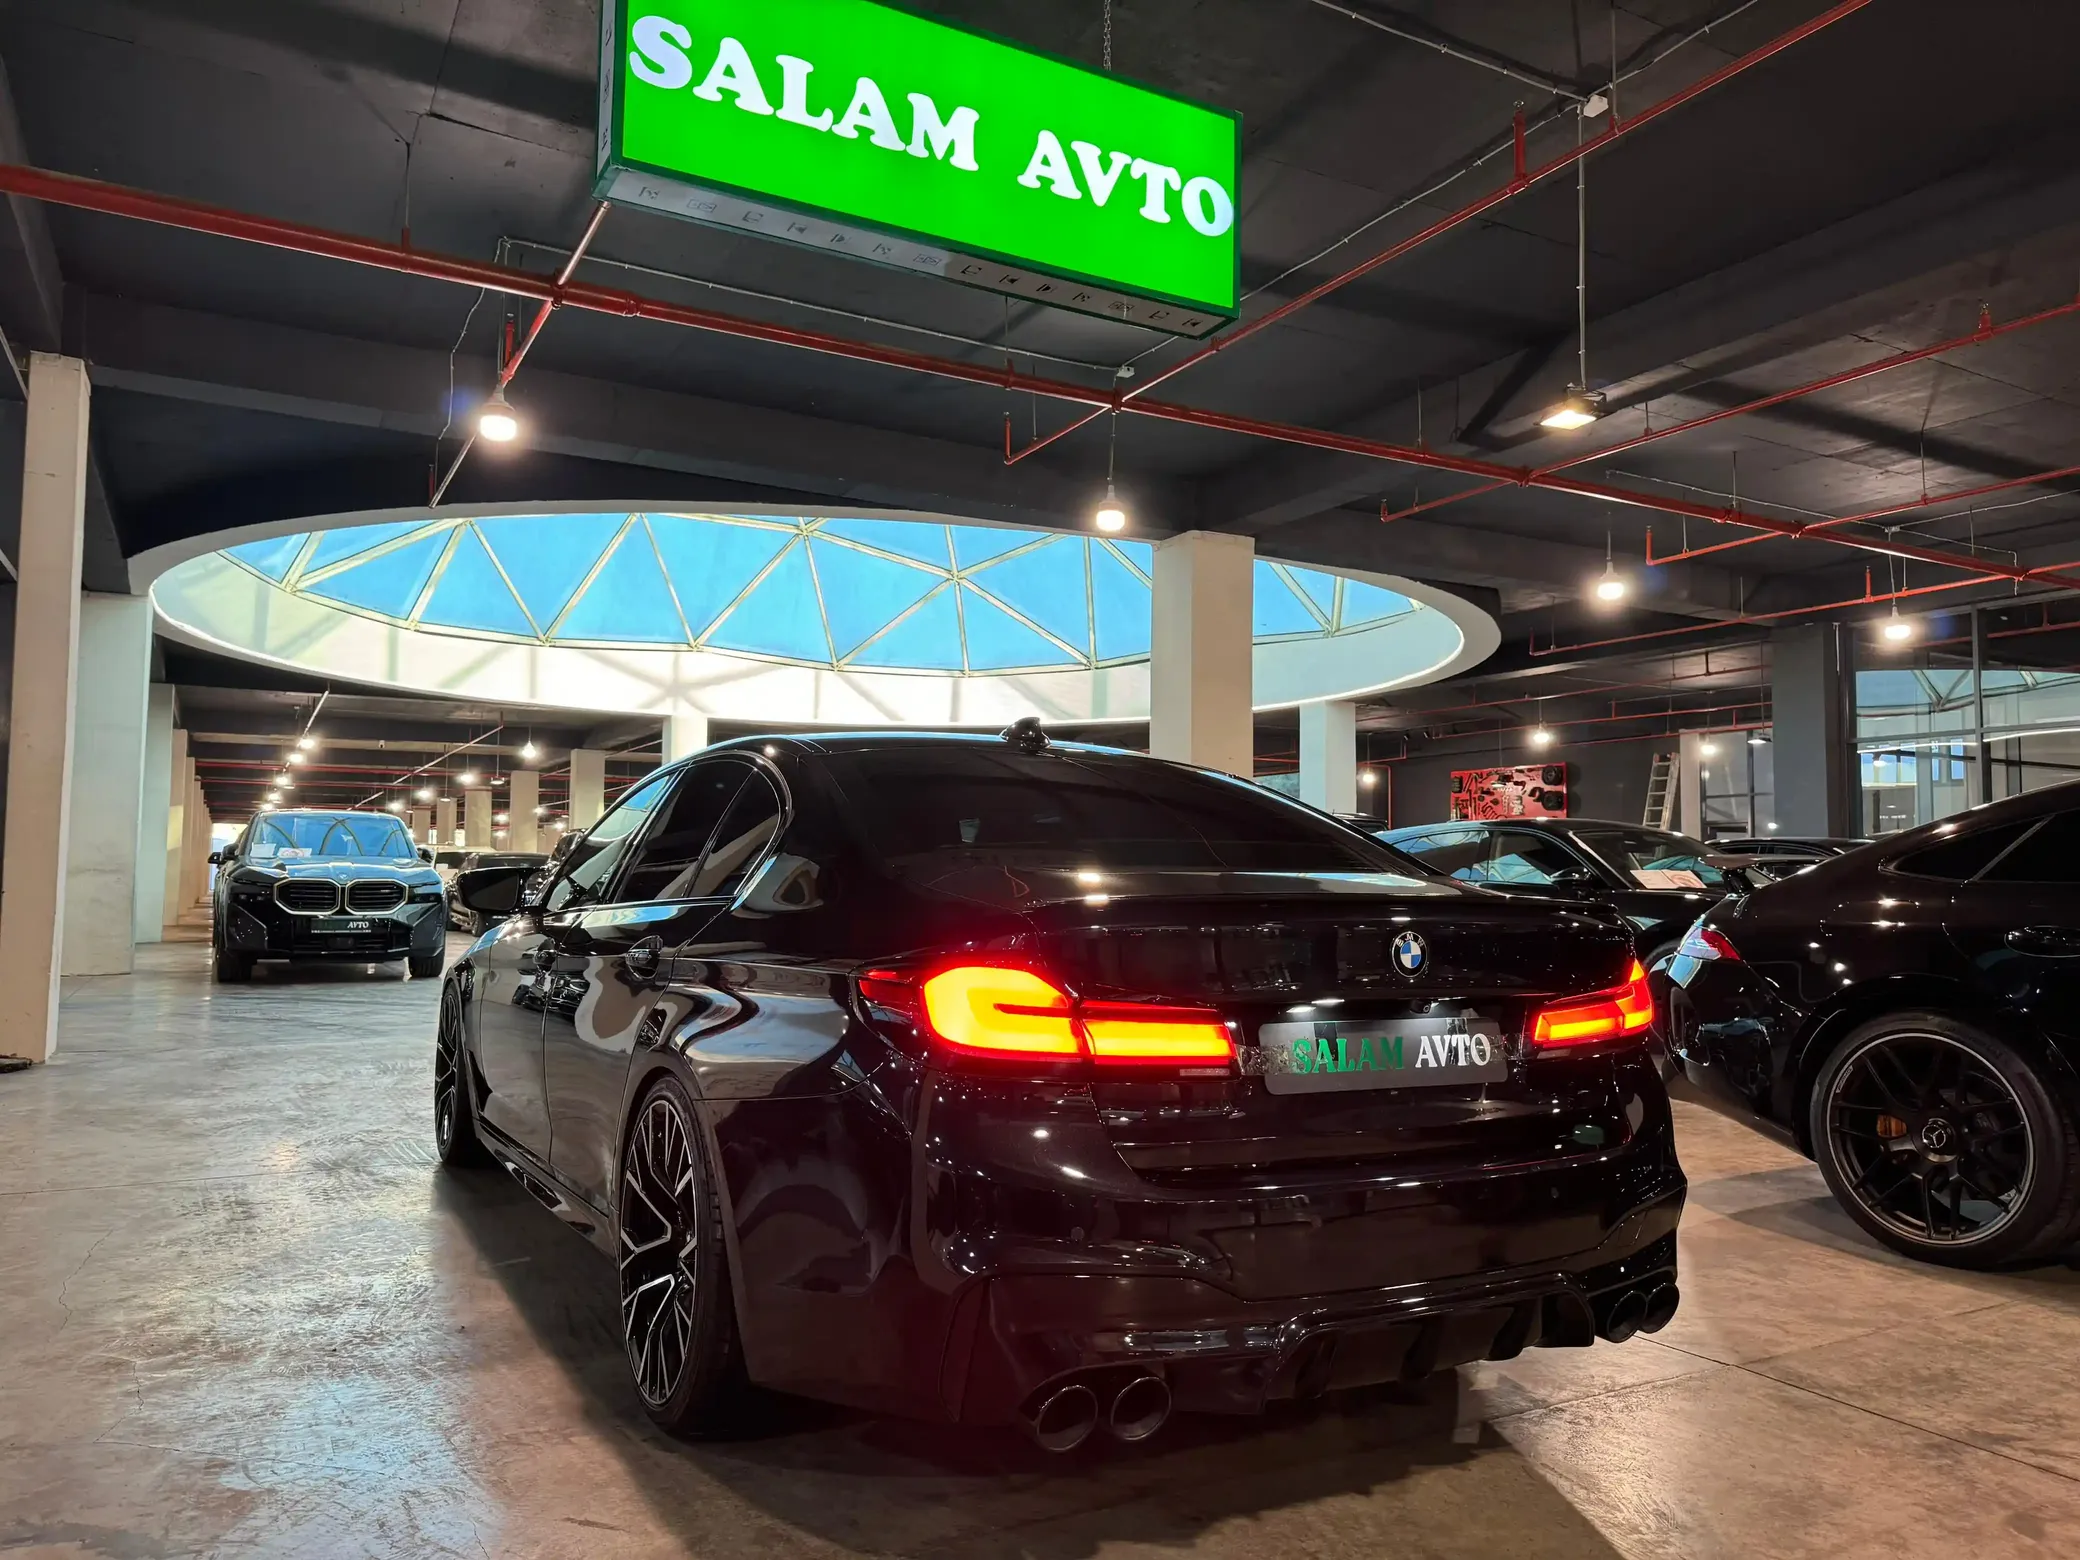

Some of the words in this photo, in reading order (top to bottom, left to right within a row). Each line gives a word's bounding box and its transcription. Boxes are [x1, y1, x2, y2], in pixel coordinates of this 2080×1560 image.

[629, 15, 979, 172] SALAM
[1017, 130, 1234, 237] AVTO
[347, 921, 369, 929] AVTO
[1292, 1036, 1404, 1075] SALAM
[1415, 1033, 1491, 1068] AVTO
